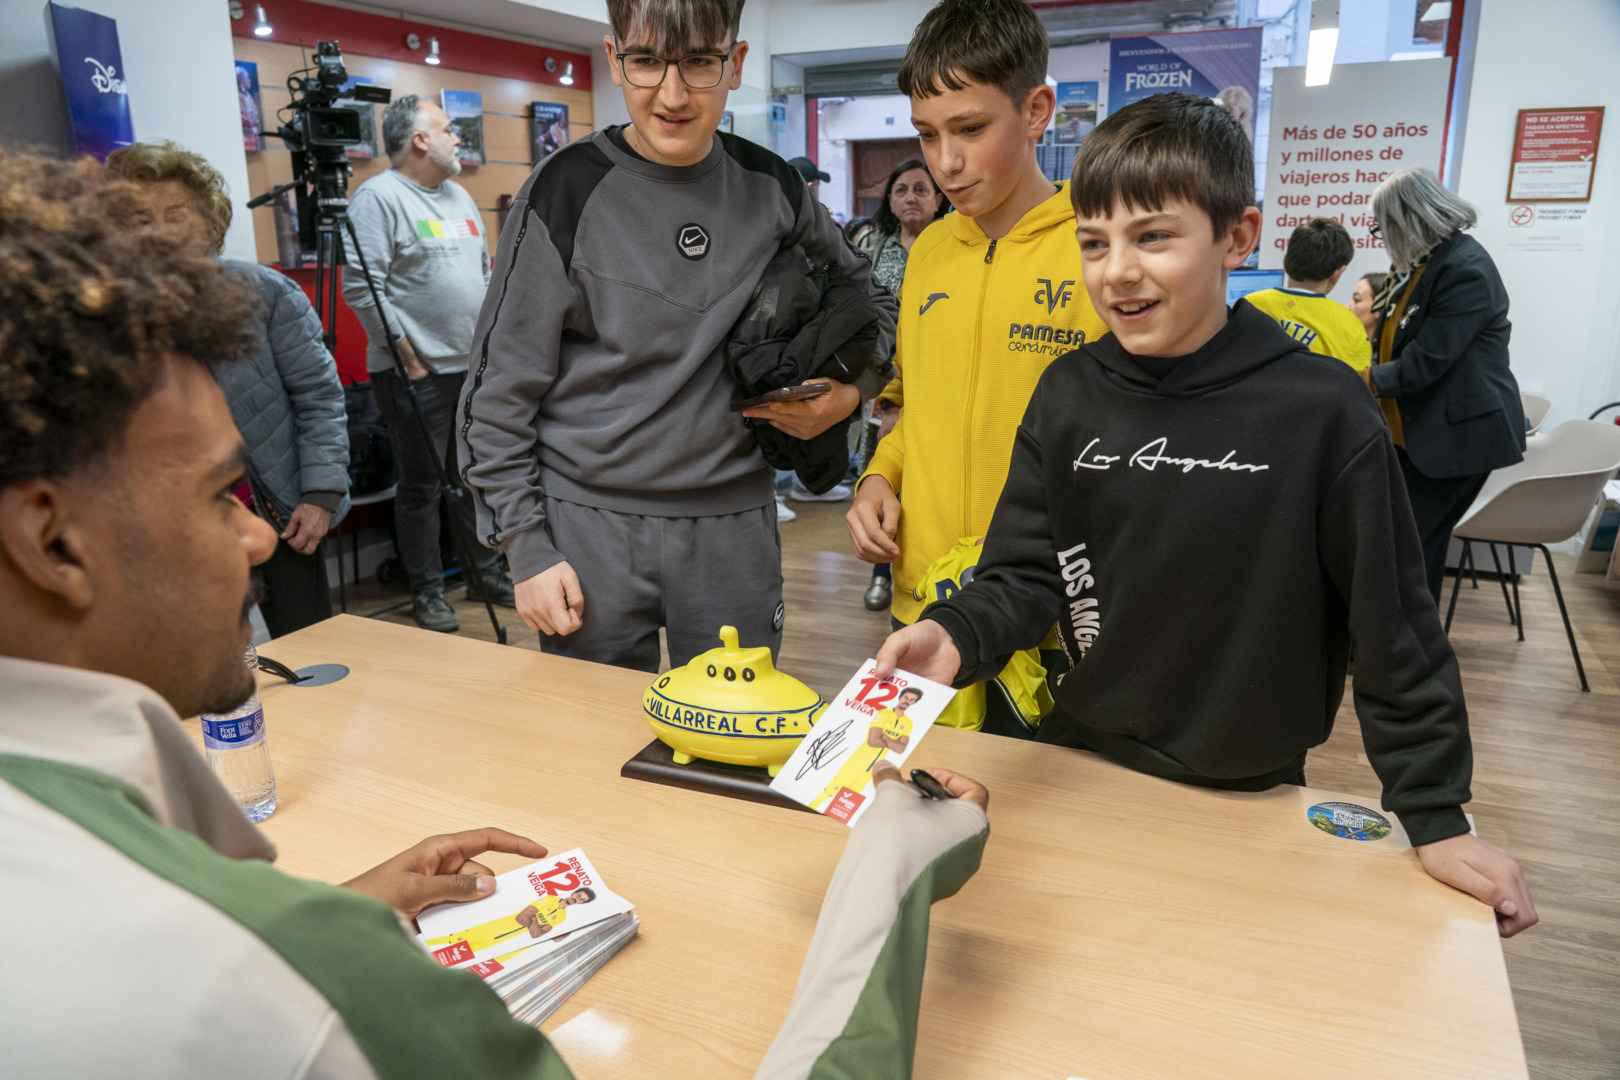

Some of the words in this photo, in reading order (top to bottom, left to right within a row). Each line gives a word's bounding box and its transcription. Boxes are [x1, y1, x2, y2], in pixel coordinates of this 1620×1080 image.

[1137, 64, 1168, 72] WORLD
[1169, 62, 1181, 70] OF
[1125, 69, 1192, 92] FROZEN
[1283, 125, 1318, 141] Más
[1323, 125, 1347, 139] de
[1352, 124, 1377, 138] 50
[1383, 122, 1428, 137] años
[1281, 152, 1291, 165] y
[1297, 148, 1374, 162] millones
[1379, 146, 1403, 160] de
[1280, 170, 1349, 187] viajeros
[1355, 169, 1391, 183] hac
[1277, 195, 1311, 208] que
[1276, 213, 1312, 227] dart
[1351, 213, 1377, 227] via
[1009, 323, 1086, 346] PAMESA
[1008, 341, 1073, 356] cerámic
[1073, 437, 1120, 472] Los
[1129, 436, 1270, 473] Angeles
[1057, 542, 1095, 598] LOS
[854, 677, 899, 711] 12
[650, 697, 743, 733] VILLARREAL
[845, 699, 875, 716] VEIGA
[538, 861, 580, 897] 12
[567, 856, 592, 886] RENATO
[527, 871, 546, 897] VEIGA
